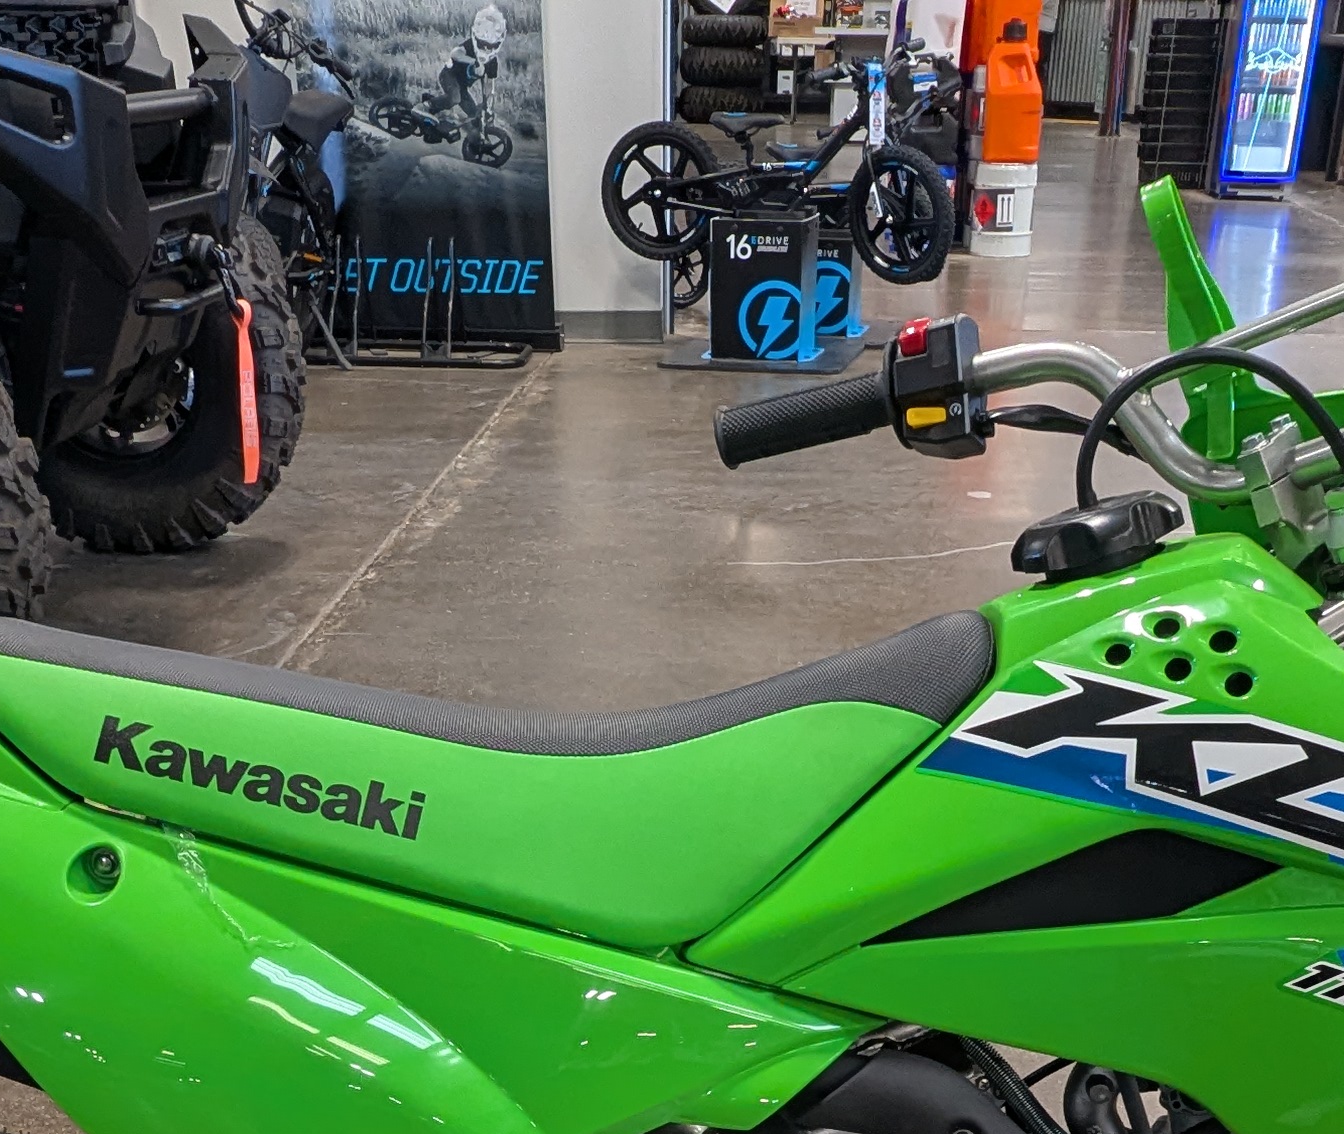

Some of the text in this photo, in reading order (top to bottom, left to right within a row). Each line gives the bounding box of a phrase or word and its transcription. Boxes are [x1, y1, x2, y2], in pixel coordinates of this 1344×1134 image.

[725, 233, 752, 260] 16
[816, 248, 840, 258] RIVE
[328, 257, 545, 294] ET OUTSIDE
[93, 714, 427, 841] Kawasaki
